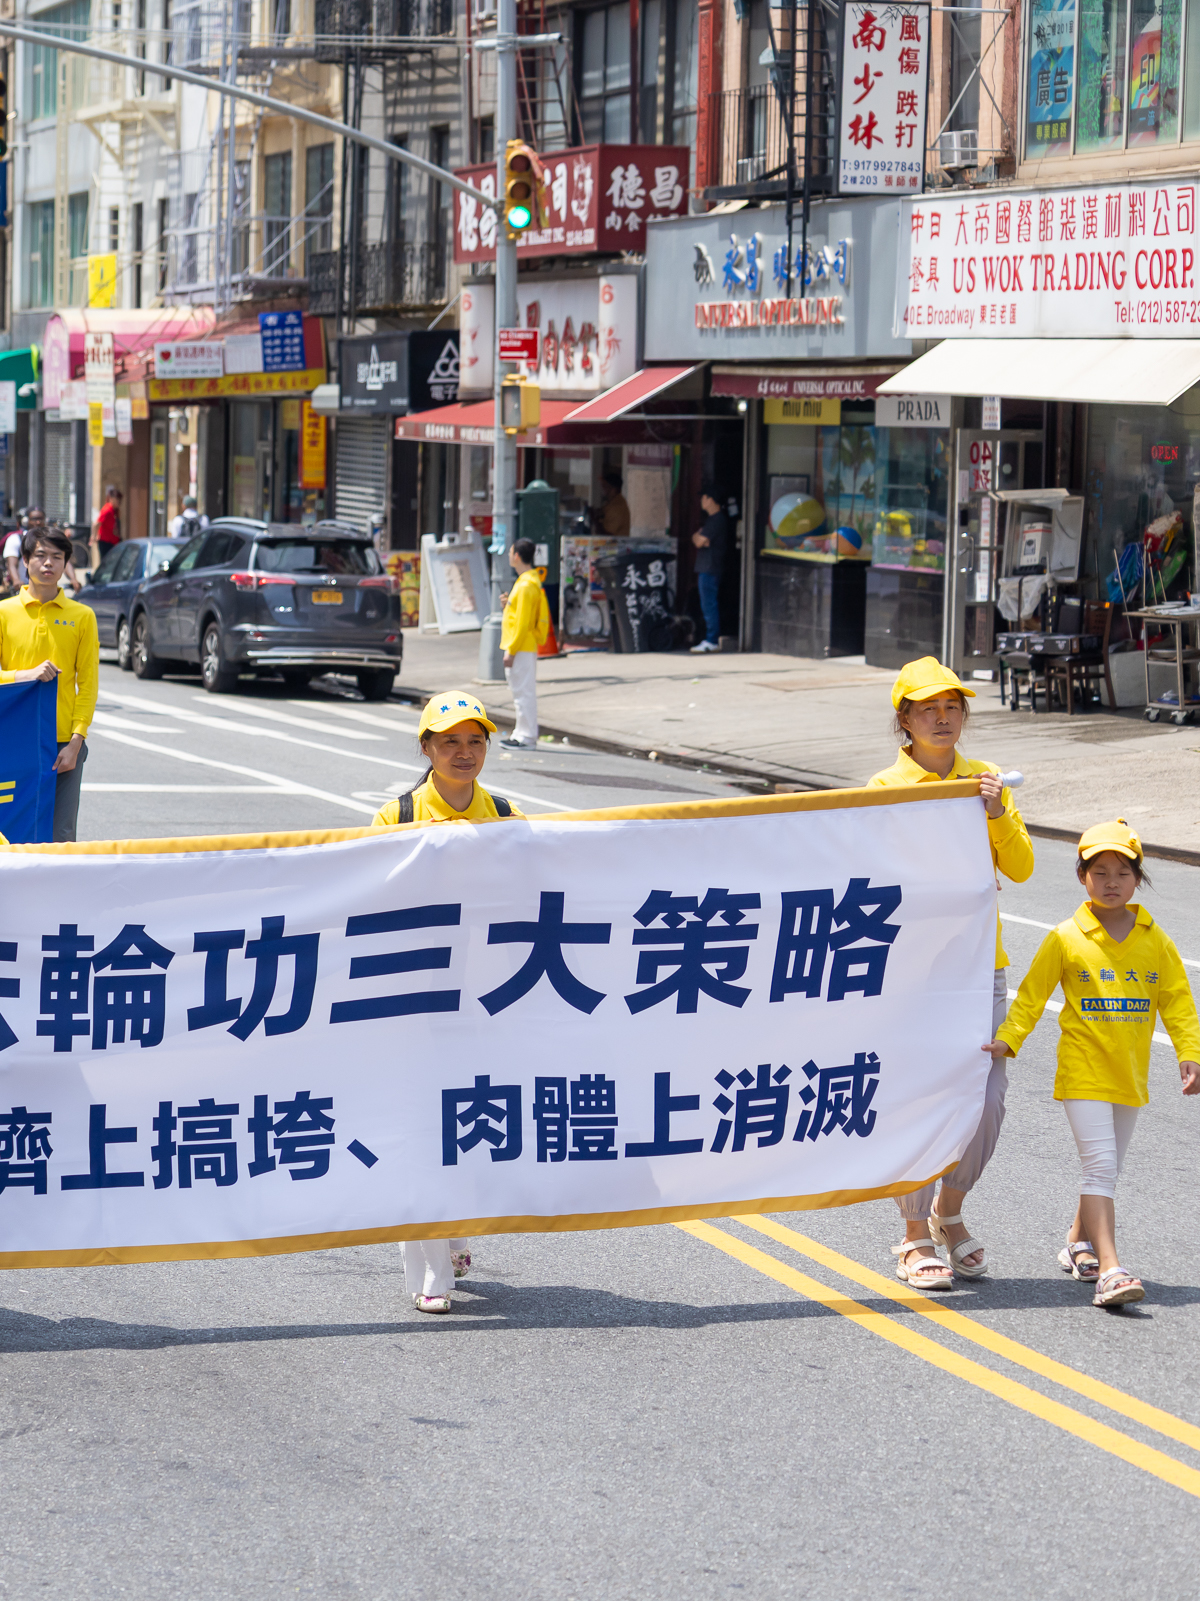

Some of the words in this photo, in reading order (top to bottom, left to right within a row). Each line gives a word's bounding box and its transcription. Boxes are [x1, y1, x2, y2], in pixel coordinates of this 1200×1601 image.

[898, 15, 921, 75] 風傷
[848, 10, 886, 150] 南少林
[1036, 66, 1069, 107] 廣告
[895, 90, 918, 148] 跌打
[606, 163, 684, 210] 德昌
[911, 208, 941, 244] 中日
[955, 186, 1195, 246] 大帝國餐館裝潢材料公司
[953, 257, 977, 294] US
[982, 254, 1024, 293] WOK
[1030, 250, 1127, 292] TRADING
[1135, 248, 1195, 290] CORP.
[695, 301, 757, 329] UNIVERSAL
[759, 298, 813, 326] OPTICAL
[927, 304, 975, 330] Broadway
[1115, 301, 1134, 323] Tel:
[1136, 299, 1163, 325] (212)
[897, 400, 941, 421] PRADA
[1151, 445, 1179, 460] OPEN
[621, 560, 666, 590] 永昌
[1077, 967, 1160, 984] 法輪大法
[1083, 1000, 1123, 1010] FALUN
[1126, 1000, 1149, 1011] DAFA
